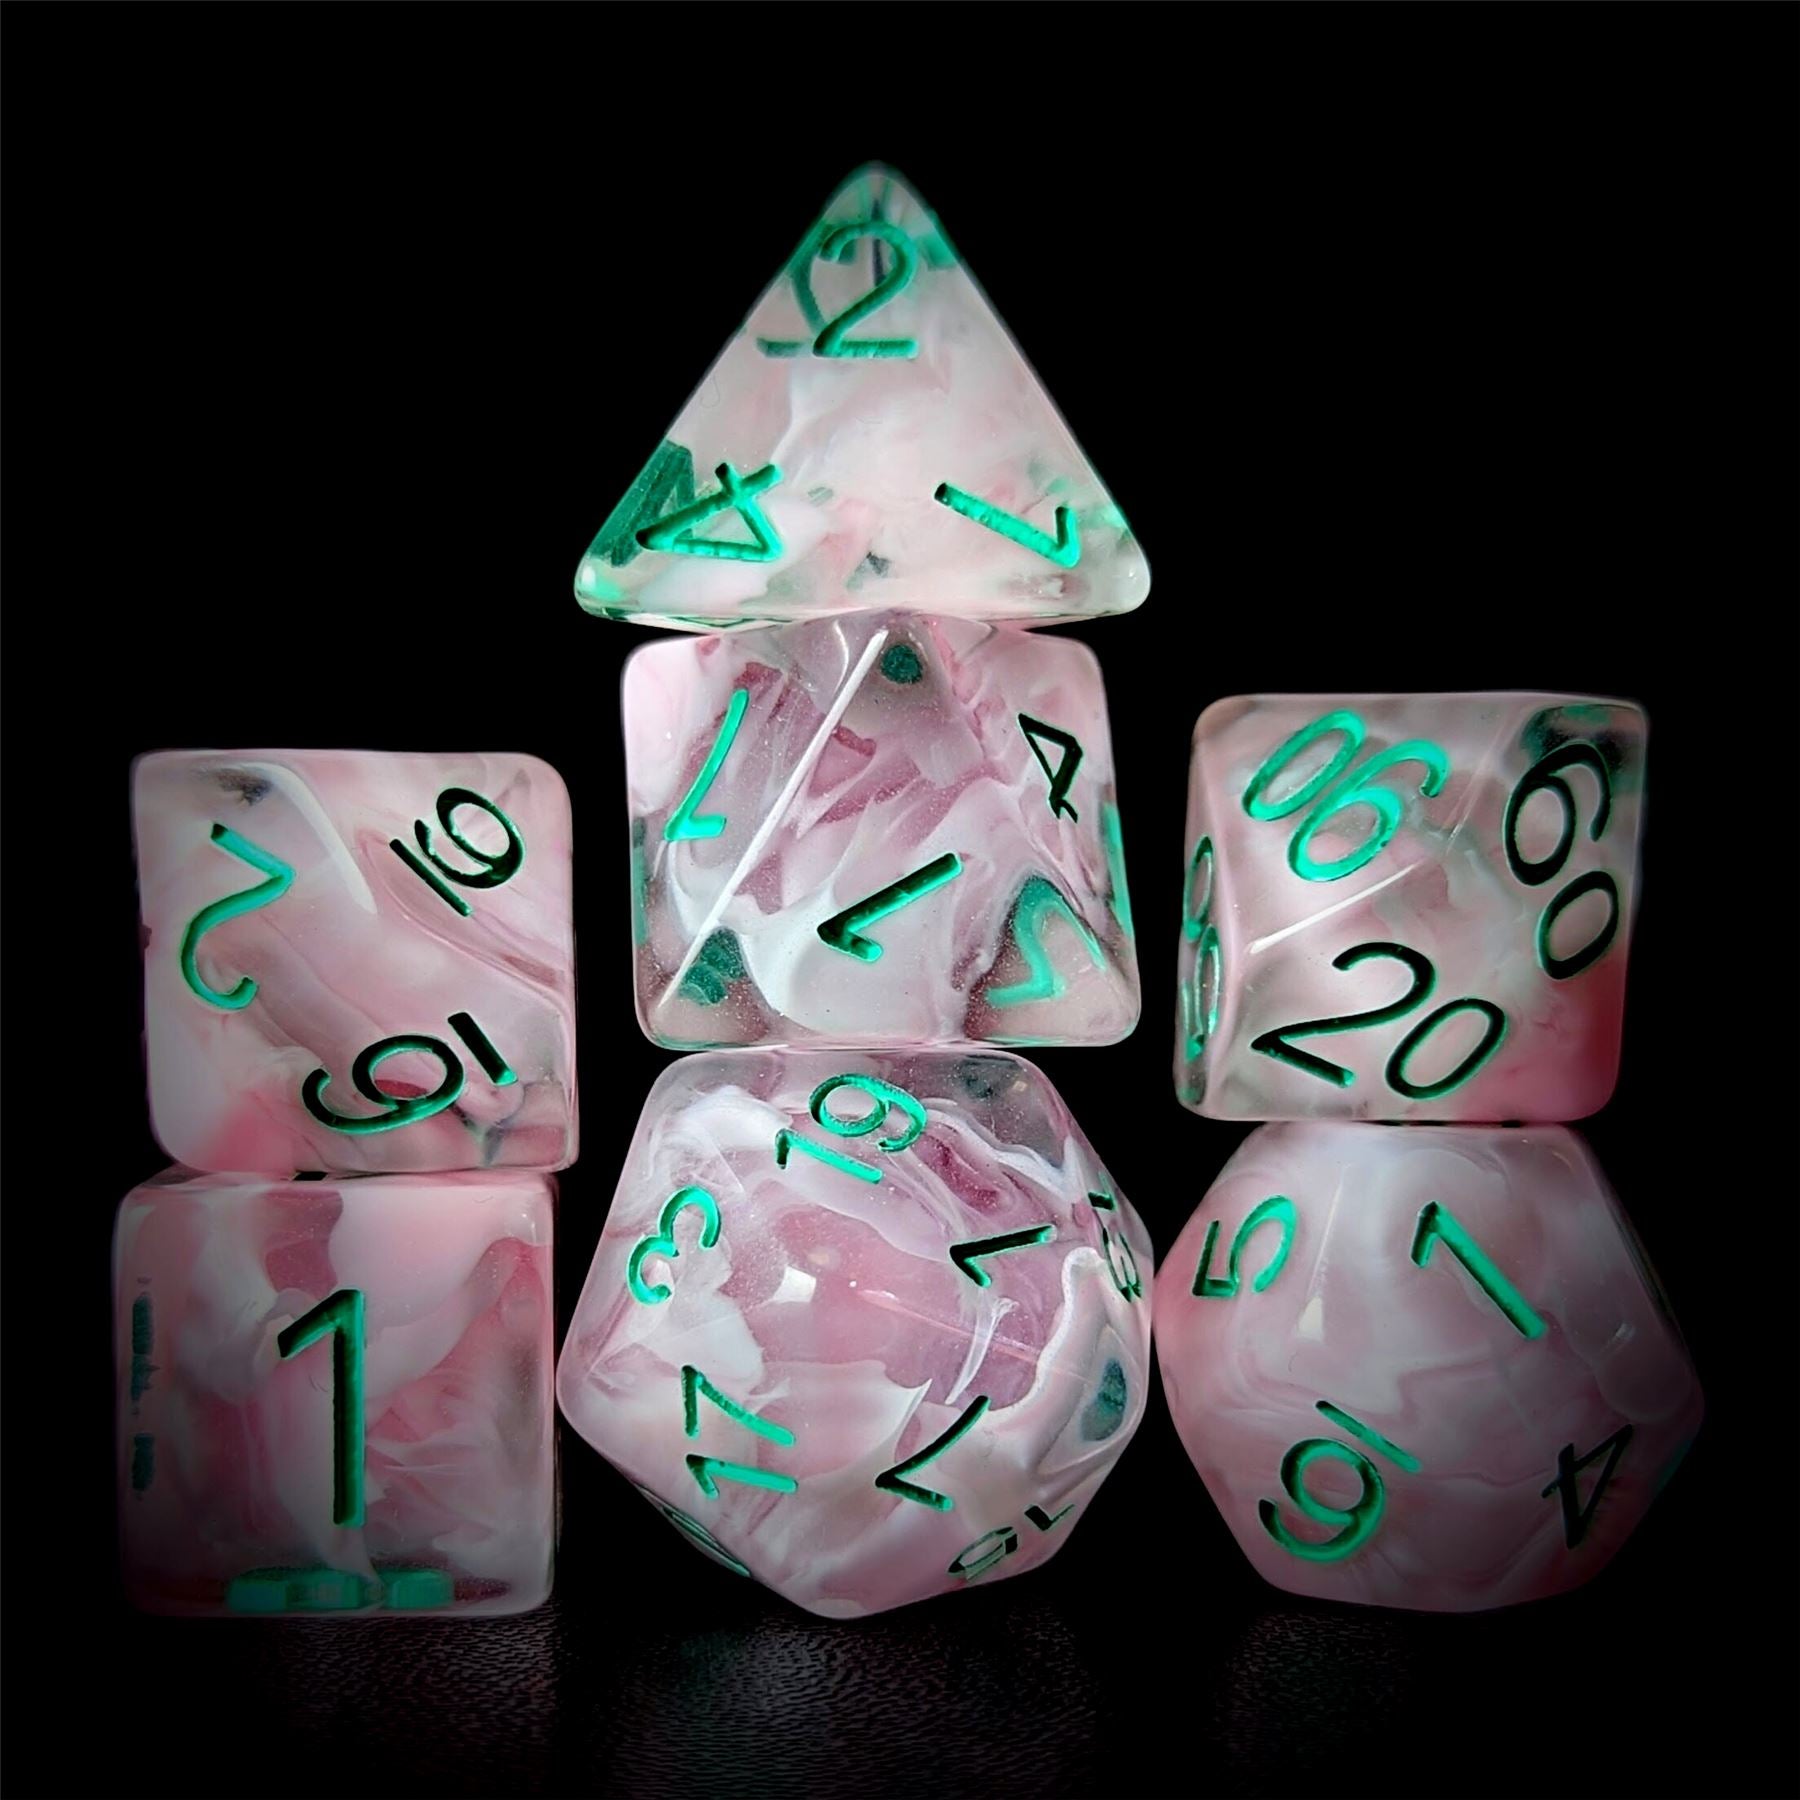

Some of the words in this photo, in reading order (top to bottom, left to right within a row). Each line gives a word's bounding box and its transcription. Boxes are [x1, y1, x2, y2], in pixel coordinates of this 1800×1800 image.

[813, 220, 917, 358] 2
[636, 463, 781, 563] 4
[934, 483, 1082, 568] 1
[1017, 711, 1084, 823] 4
[180, 822, 297, 1011] 2
[816, 851, 964, 963] 1
[1249, 941, 1506, 1101] 20
[773, 1072, 926, 1185] 19
[626, 1185, 722, 1305] 3
[949, 1224, 1058, 1289] 1
[1192, 1194, 1299, 1298] 5
[1410, 1201, 1549, 1340] 1
[277, 1288, 366, 1529] 1
[1541, 1422, 1634, 1551] 4
